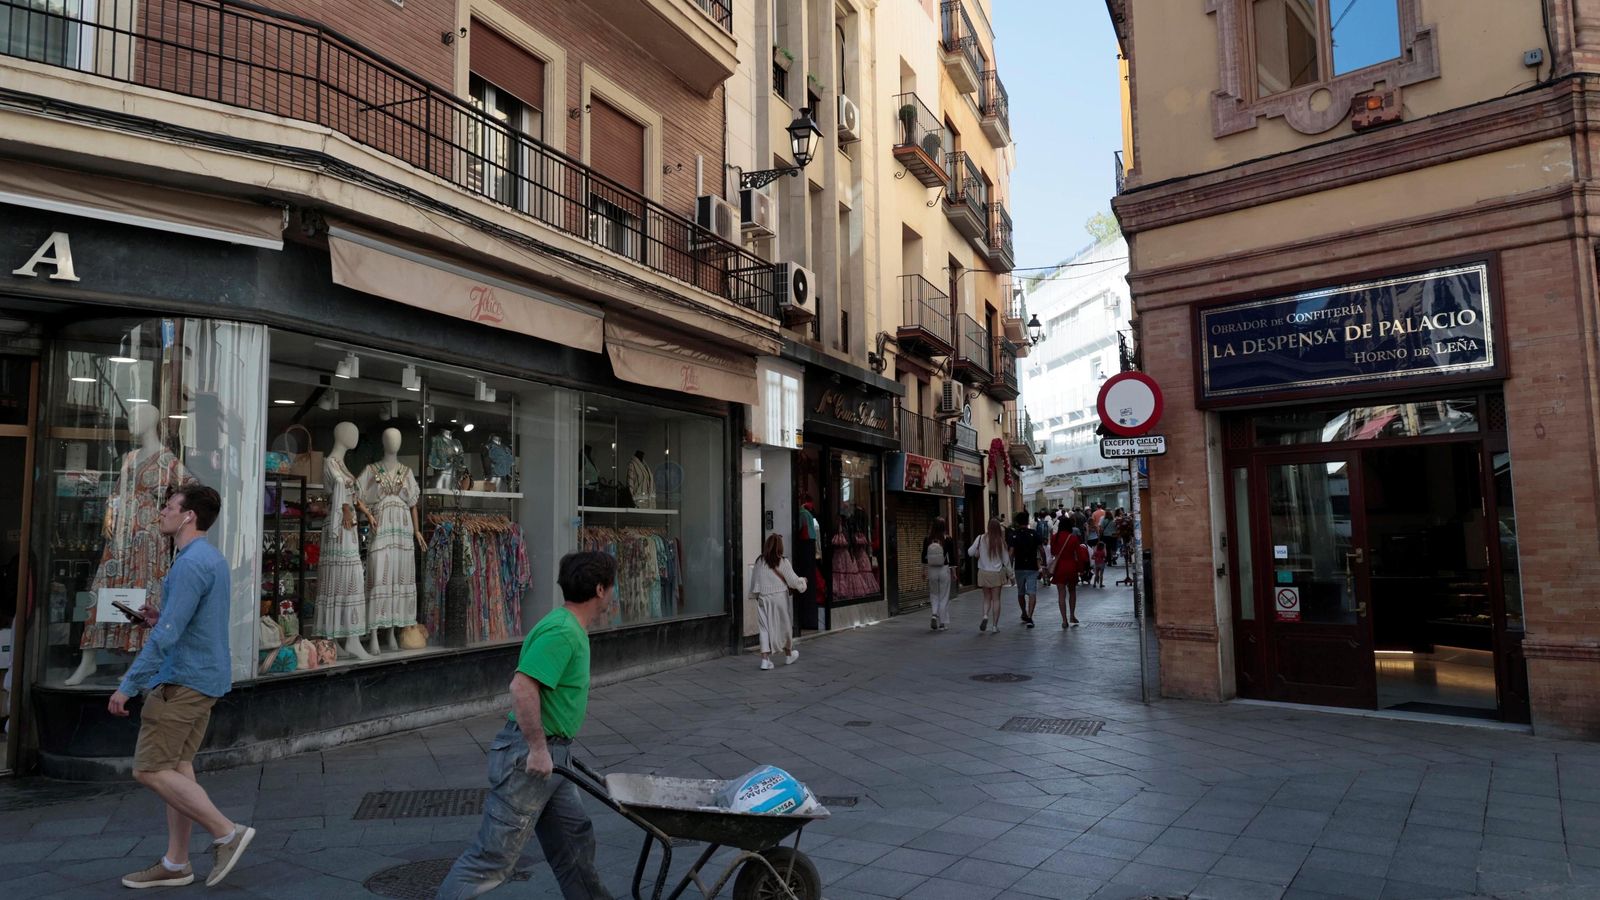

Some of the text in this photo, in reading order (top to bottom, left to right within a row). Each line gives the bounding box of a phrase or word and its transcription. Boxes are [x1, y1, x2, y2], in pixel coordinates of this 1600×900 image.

[12, 231, 80, 281] A
[1211, 303, 1364, 336] OBRADOR DE CONFITERÍA
[1213, 309, 1476, 359] LA DESPENSA DE PALACIO
[1354, 338, 1479, 364] HORNO DE LEÑA
[1104, 437, 1163, 447] EXCEPTO CICLOS
